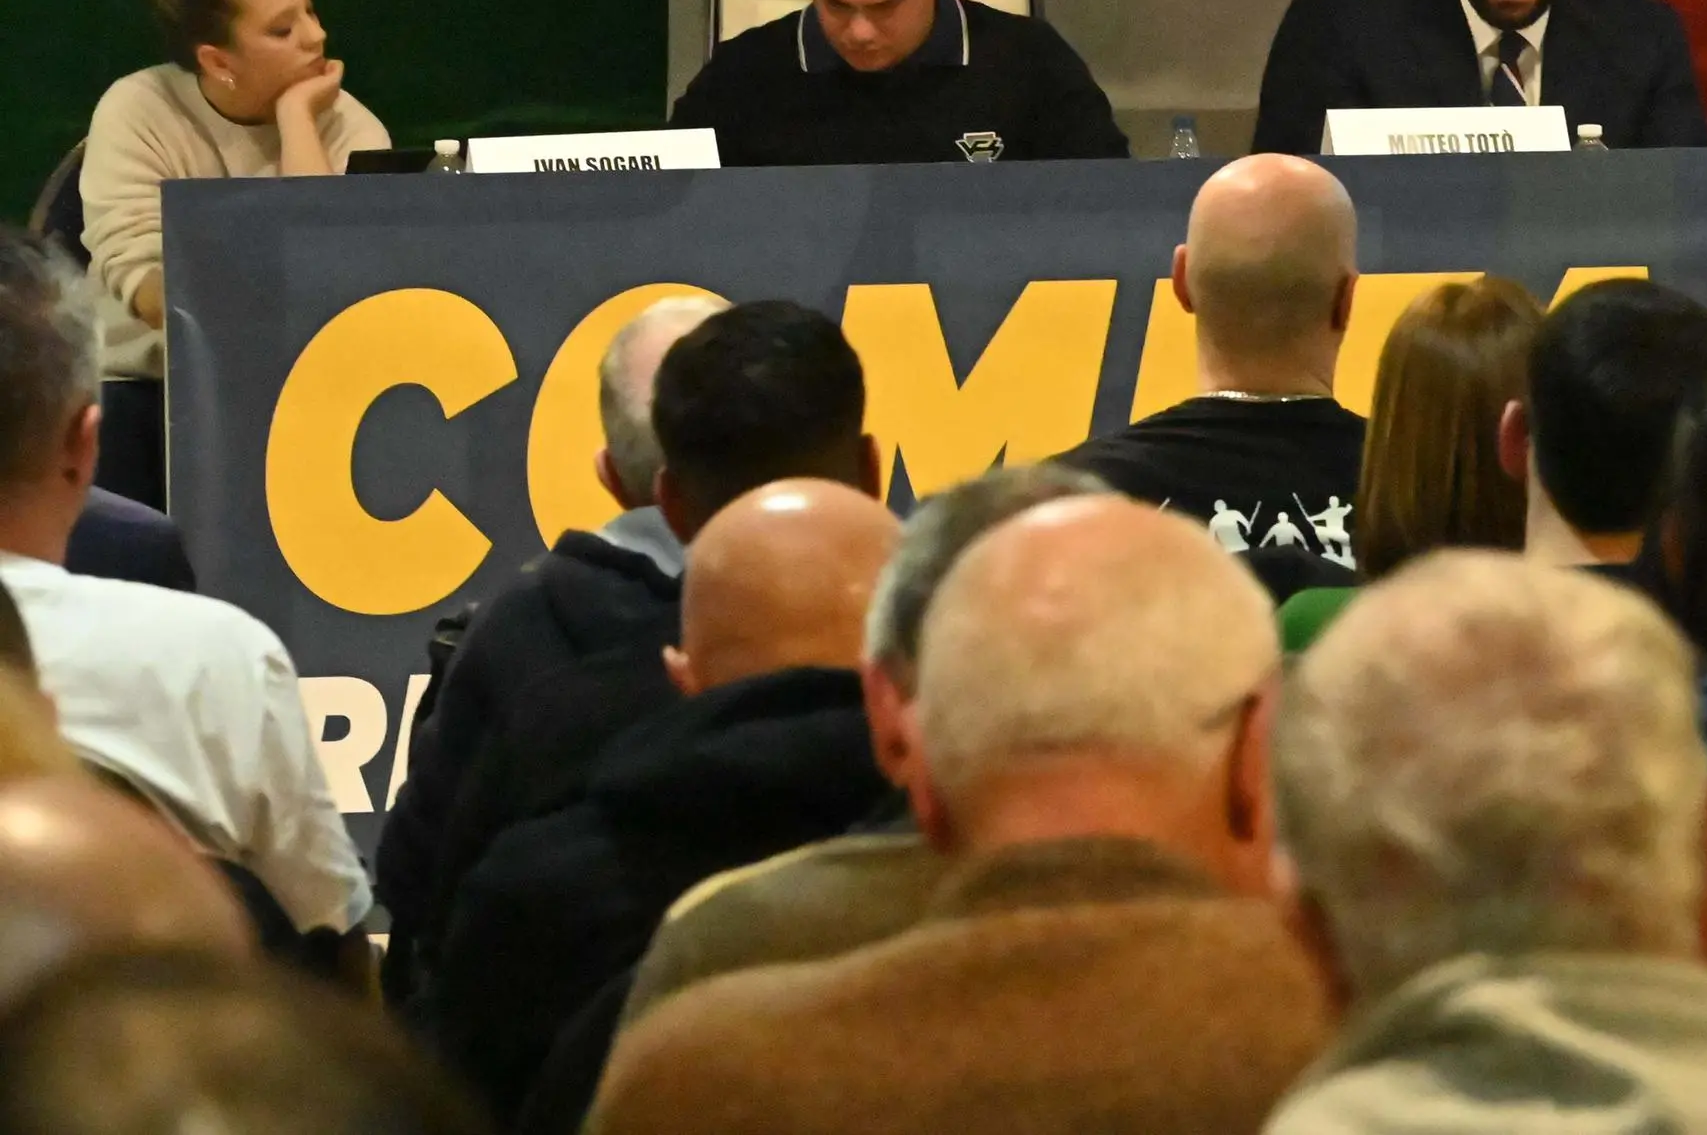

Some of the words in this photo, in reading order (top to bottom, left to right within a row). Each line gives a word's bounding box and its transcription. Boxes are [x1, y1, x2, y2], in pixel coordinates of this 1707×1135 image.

[1387, 133, 1461, 155] MATTEO
[1464, 129, 1515, 153] TOTÒ
[533, 157, 581, 172] IVAN
